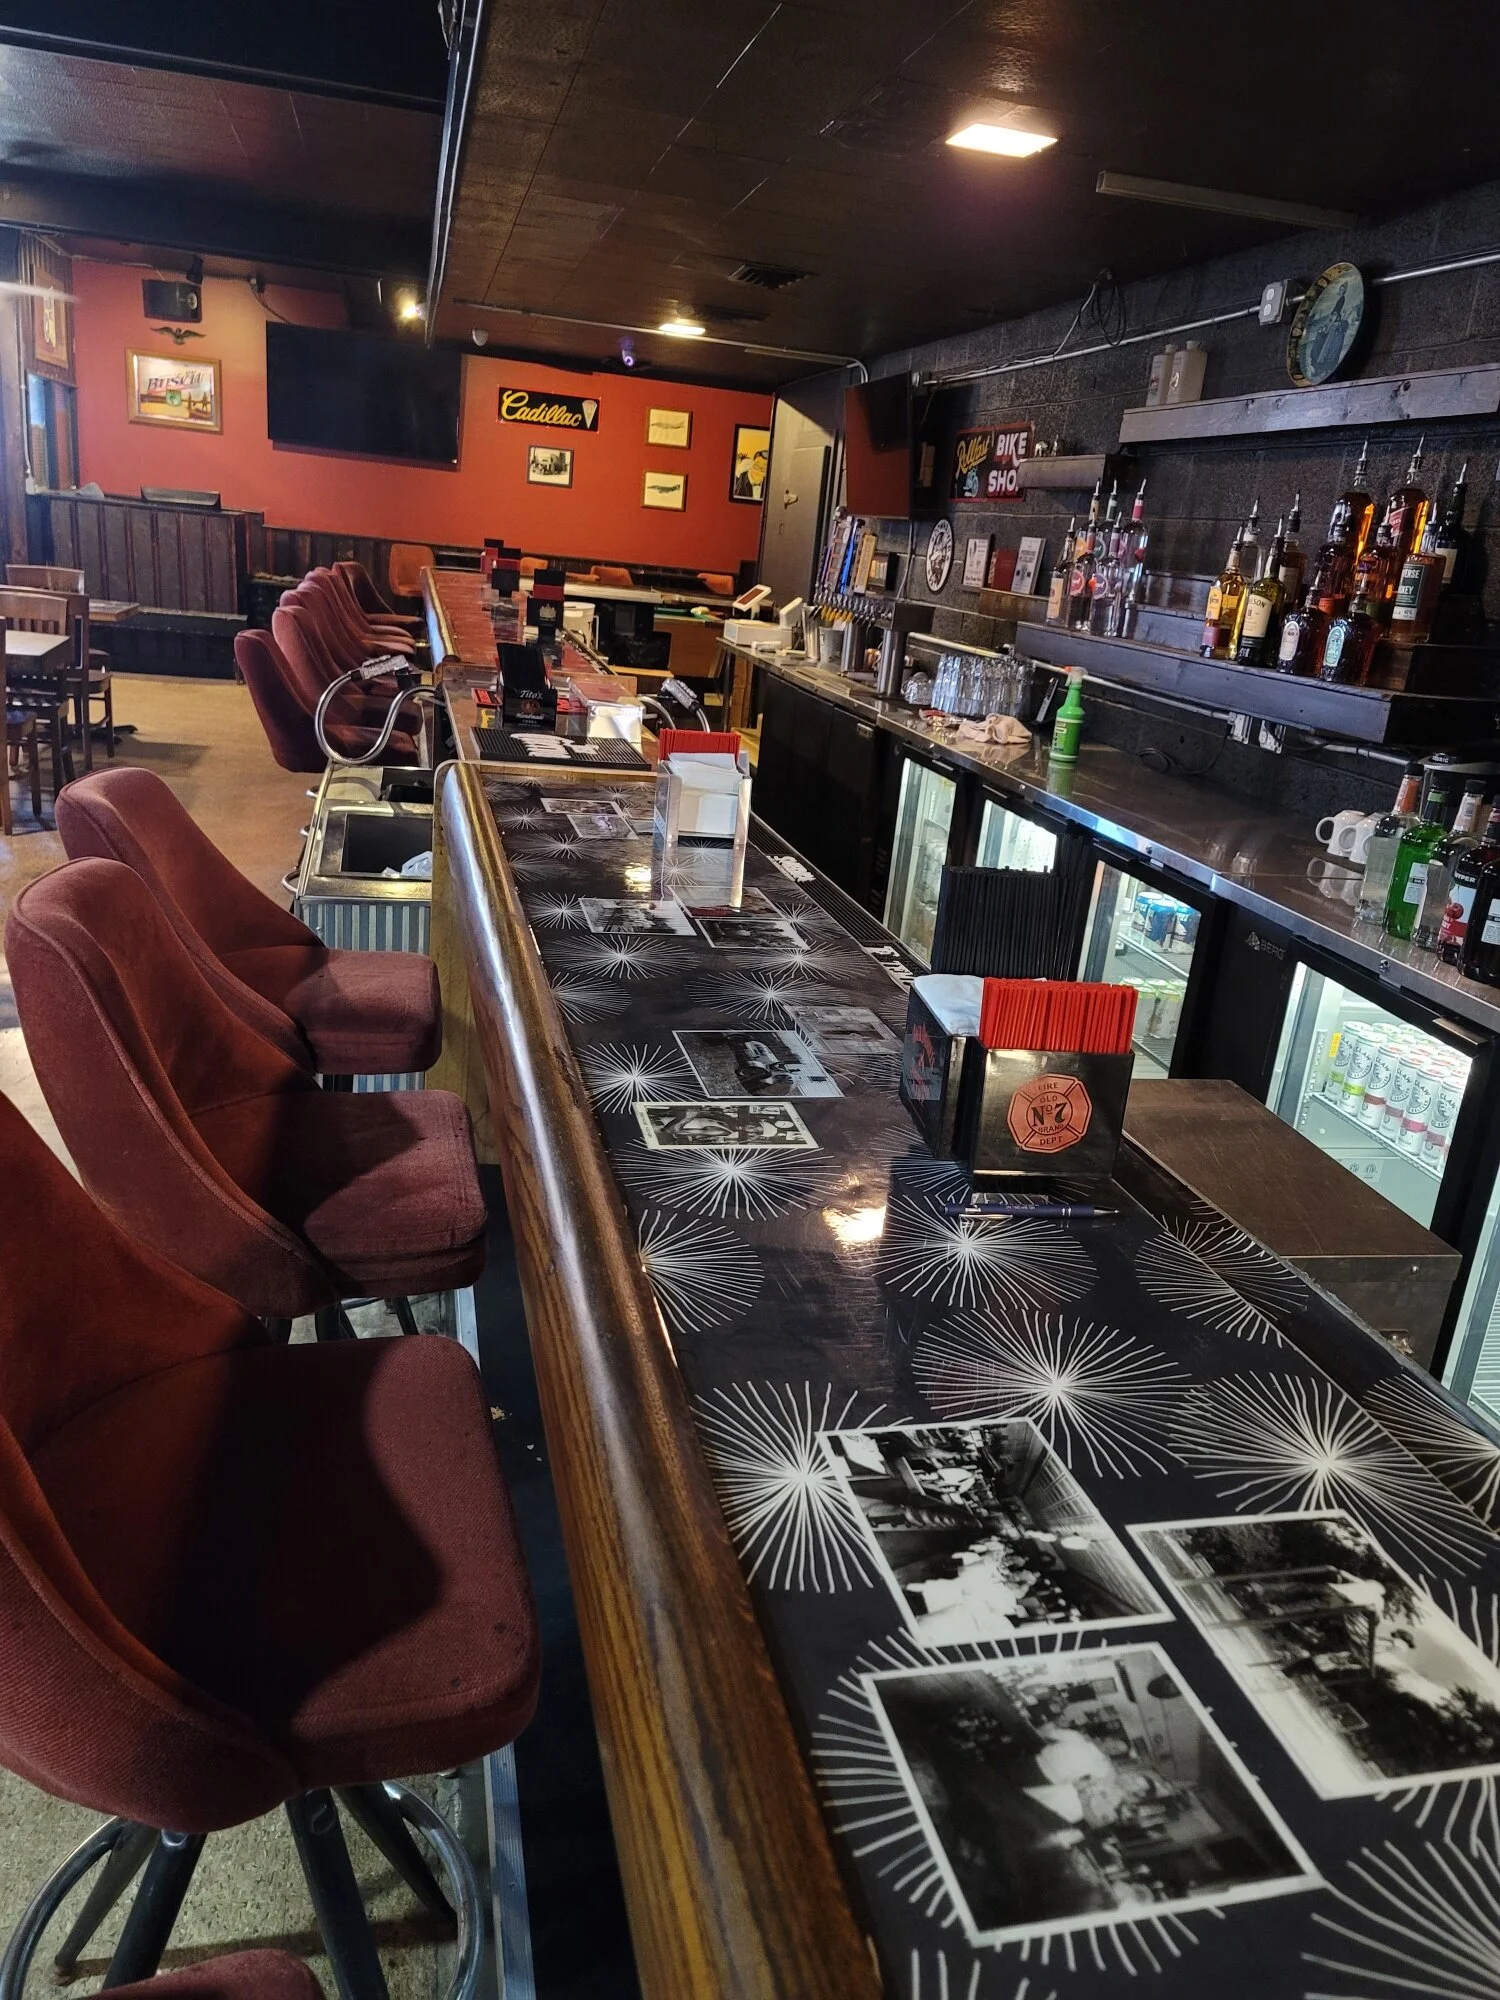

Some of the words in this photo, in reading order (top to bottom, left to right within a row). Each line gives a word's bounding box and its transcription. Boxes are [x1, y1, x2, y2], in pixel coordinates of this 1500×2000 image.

[501, 390, 582, 427] Cadillac
[996, 431, 1029, 468] BIKE
[987, 469, 1019, 493] SHO
[519, 688, 544, 700] Tito's
[1038, 1081, 1059, 1092] FIRE
[1039, 1095, 1058, 1104] OLD
[1038, 1123, 1064, 1133] BRAND
[1039, 1135, 1064, 1146] DEPT
